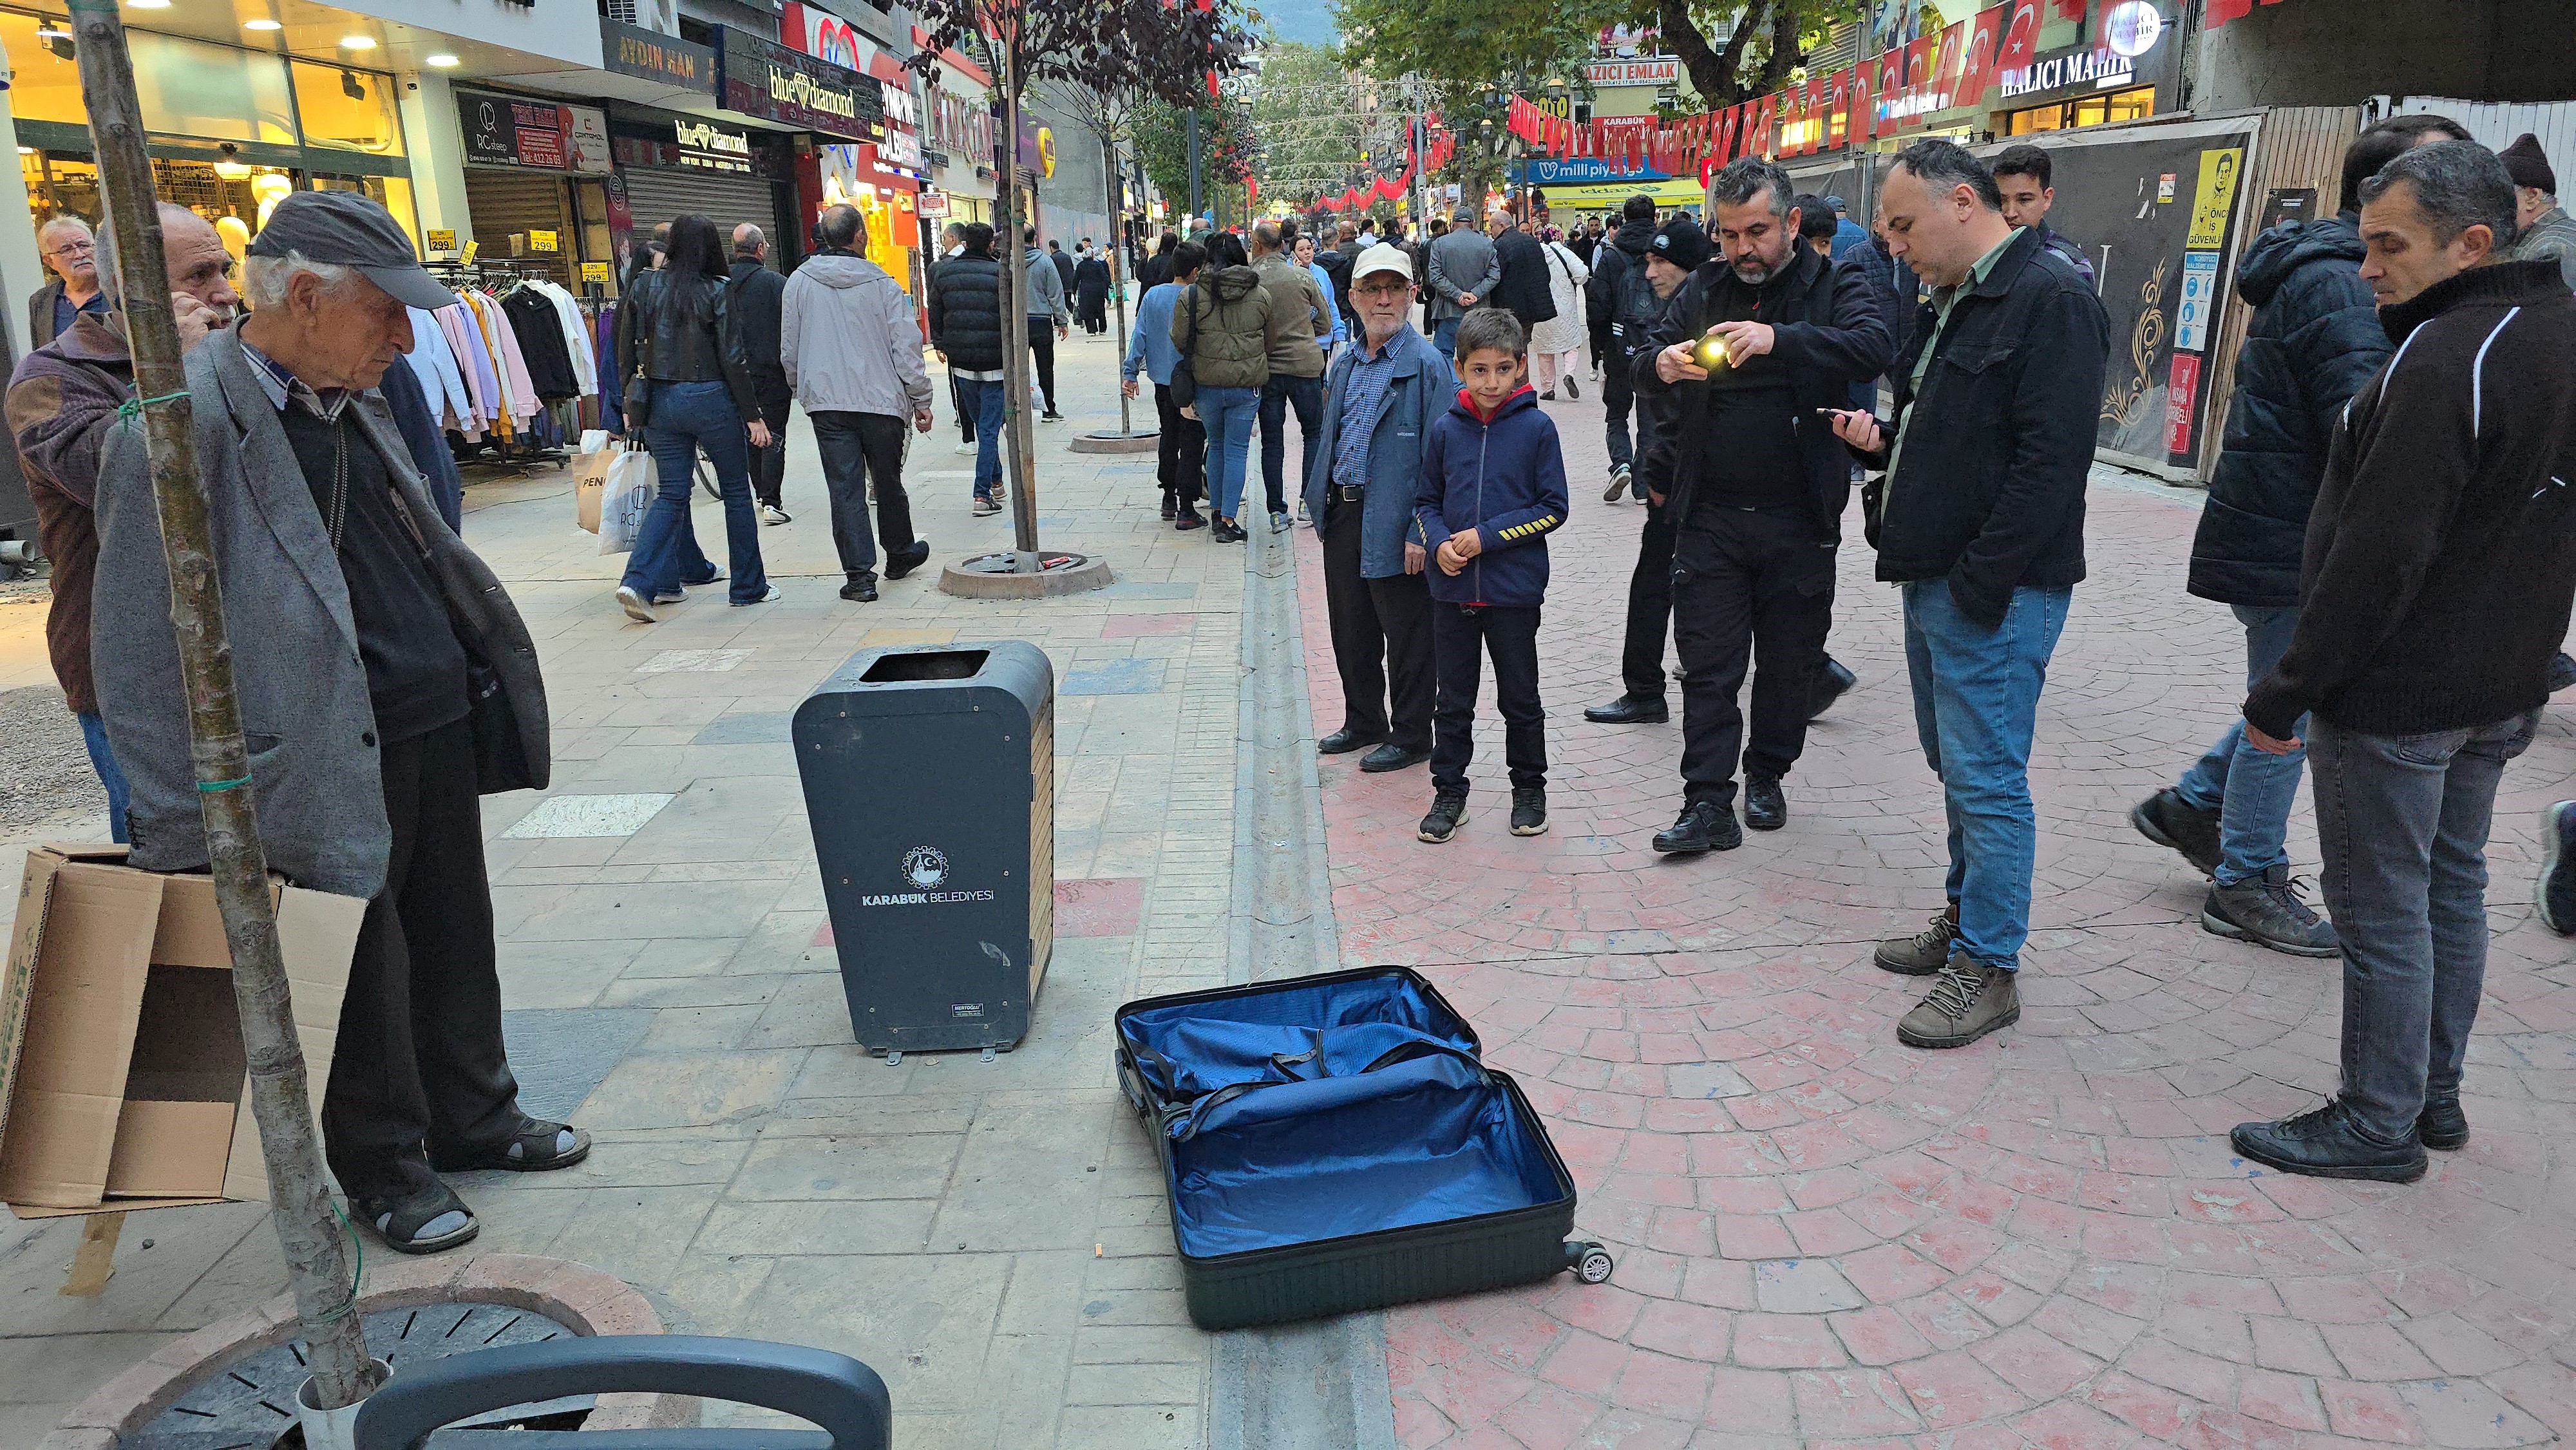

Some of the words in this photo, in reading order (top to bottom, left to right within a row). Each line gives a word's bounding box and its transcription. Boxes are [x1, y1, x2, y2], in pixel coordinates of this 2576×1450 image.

[620, 37, 663, 70] AYDIN
[666, 48, 694, 79] HAN
[1584, 65, 1622, 80] AZICI
[1626, 63, 1675, 79] EMLAK
[2000, 59, 2062, 97] HALICI
[769, 65, 797, 103] blue
[810, 78, 855, 118] diamond
[1604, 116, 1645, 126] KARABÜK
[477, 133, 491, 150] RC
[675, 119, 699, 147] blue
[710, 126, 748, 154] diamond
[534, 153, 545, 164] 412
[545, 154, 553, 164] 26
[554, 155, 561, 165] 03
[1560, 164, 1588, 176] milli
[2209, 220, 2216, 233] İŞ
[432, 241, 449, 250] 299
[535, 241, 552, 250] 299
[862, 892, 928, 906] KARABÜK
